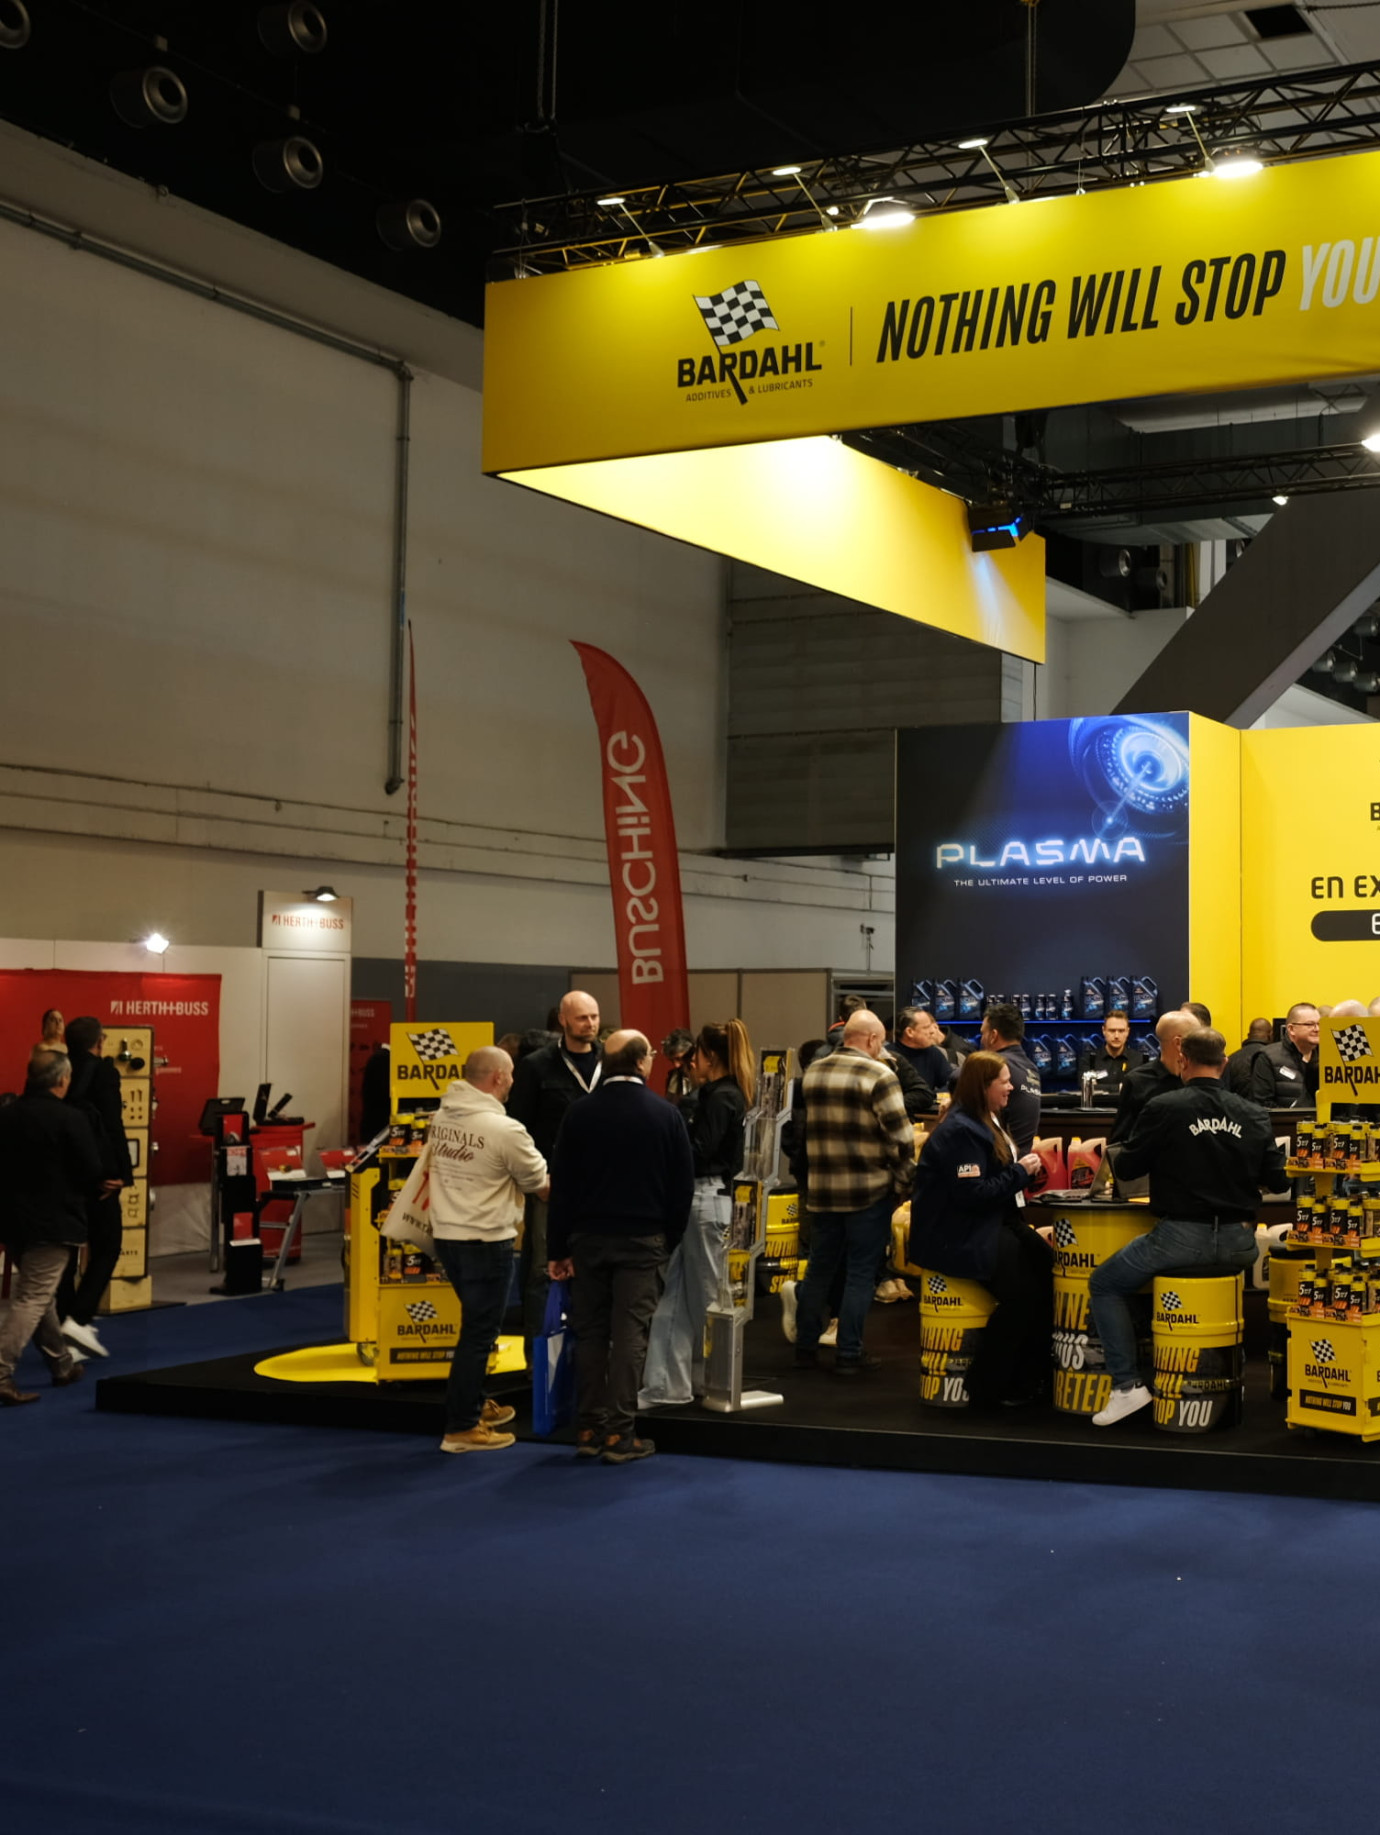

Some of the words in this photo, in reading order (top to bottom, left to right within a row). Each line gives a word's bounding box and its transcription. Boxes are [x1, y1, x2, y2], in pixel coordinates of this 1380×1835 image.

[876, 279, 1057, 364] NOTHING
[1067, 265, 1163, 339] WILL
[1175, 249, 1287, 326] STOP
[677, 342, 822, 390] BARDAHL
[685, 388, 732, 402] ADDITIVES
[748, 386, 755, 395] &
[758, 378, 813, 394] LUBRICANTS
[936, 837, 1146, 869] PLASMA
[954, 879, 974, 887] THE
[978, 877, 1029, 886] ULTIMATE
[1033, 876, 1066, 885] LEVEL
[1088, 874, 1128, 883] POWER
[126, 1002, 209, 1016] HERTH+BUSS
[397, 1063, 468, 1082] BARDA
[430, 1125, 485, 1150] RIGINALS
[1188, 1116, 1242, 1139] BARDAHL
[1156, 1312, 1200, 1324] BARDAHL
[397, 1324, 457, 1336] BARDAHL
[1305, 1364, 1351, 1382] BARDAHL
[1178, 1400, 1213, 1427] YOU
